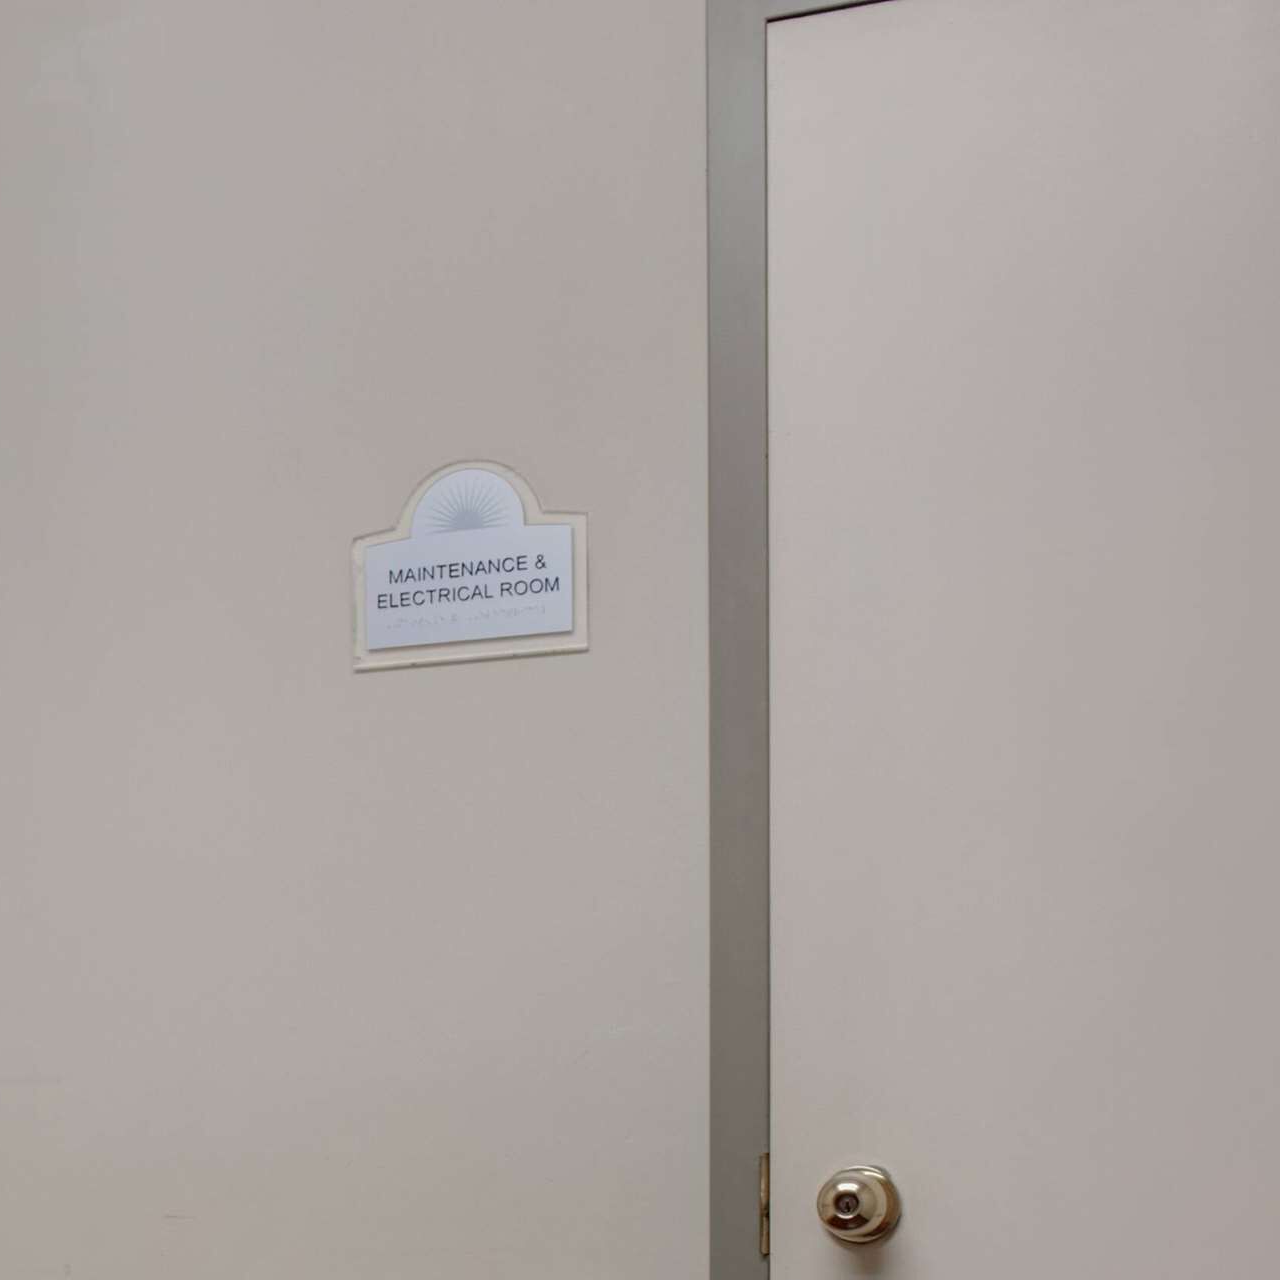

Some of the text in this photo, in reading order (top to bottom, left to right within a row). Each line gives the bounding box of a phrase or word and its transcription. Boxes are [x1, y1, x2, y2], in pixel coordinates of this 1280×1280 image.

[388, 554, 548, 584] MAINTENANCE &
[377, 577, 560, 609] ELECTRICAL ROOM
